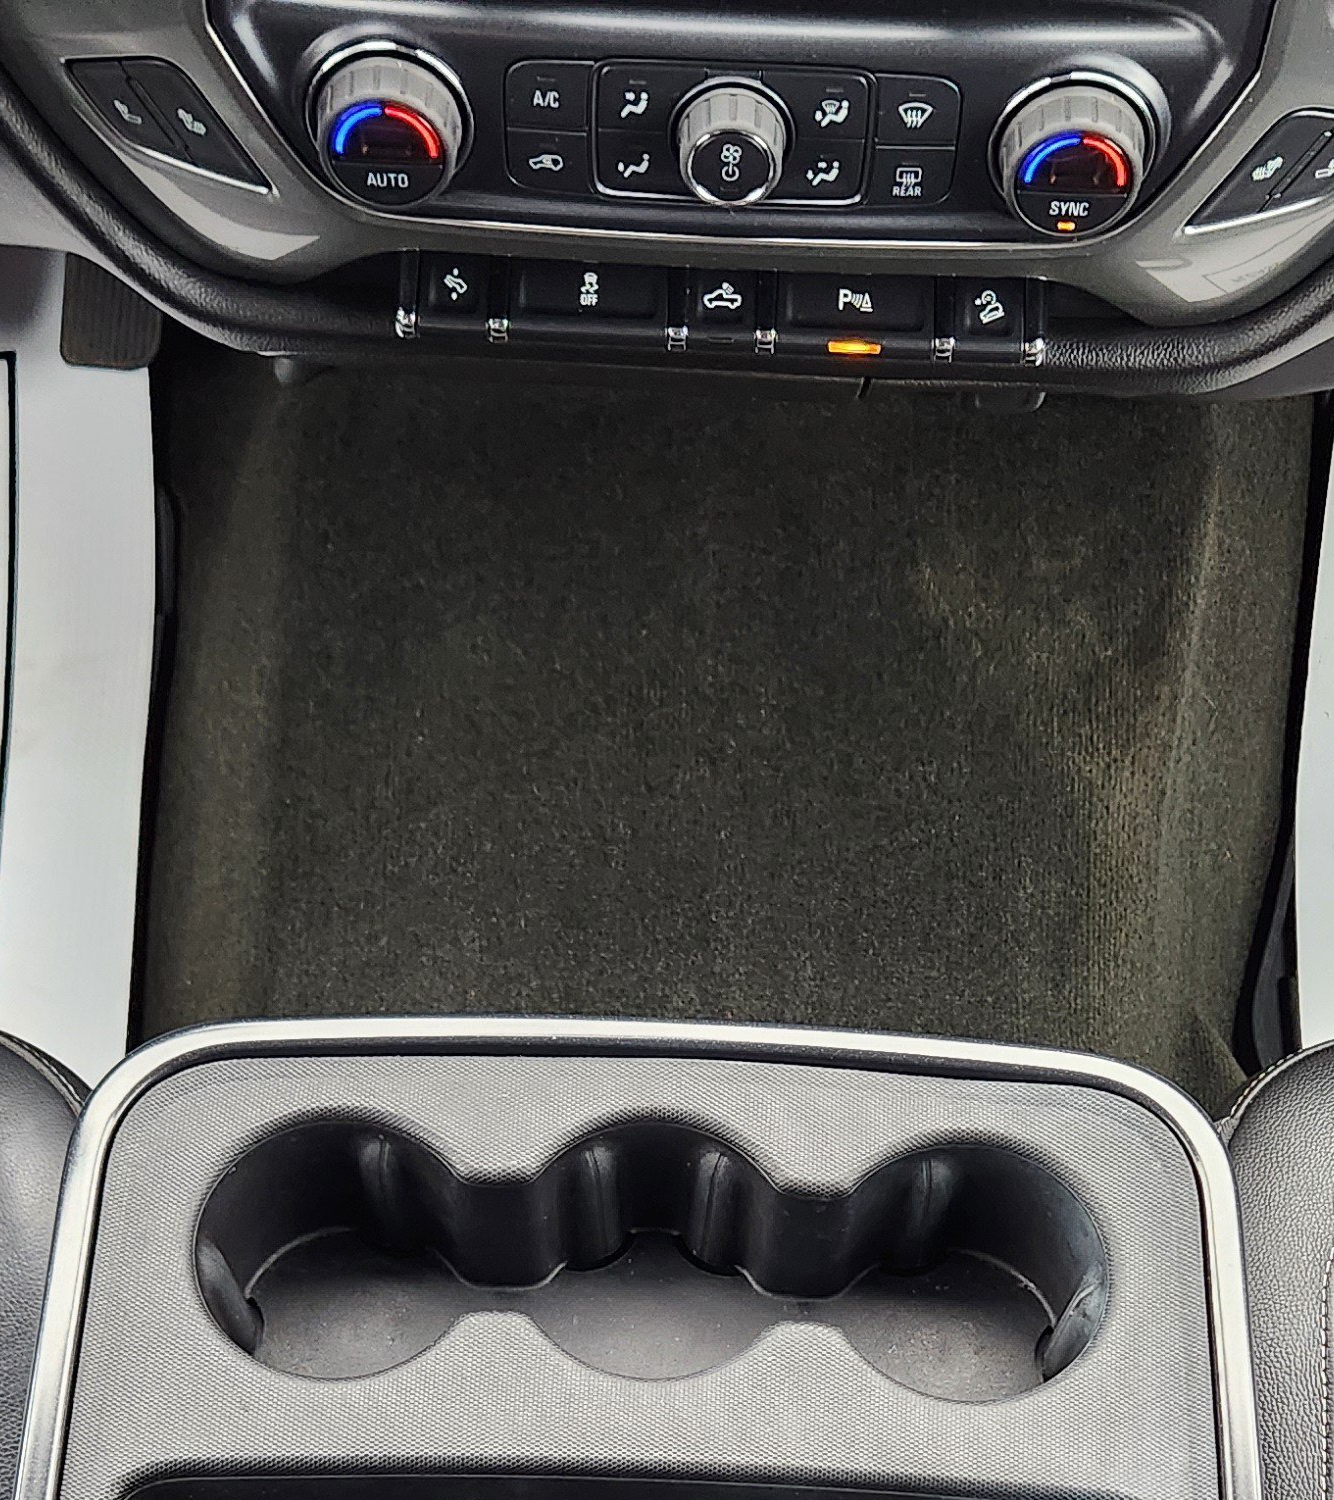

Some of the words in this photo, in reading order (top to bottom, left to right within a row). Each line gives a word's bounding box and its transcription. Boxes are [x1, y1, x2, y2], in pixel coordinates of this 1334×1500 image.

[532, 91, 560, 109] A/C
[367, 172, 409, 189] AUTO
[892, 186, 922, 197] REAR
[1049, 201, 1090, 217] SYNC
[579, 293, 599, 306] OFF
